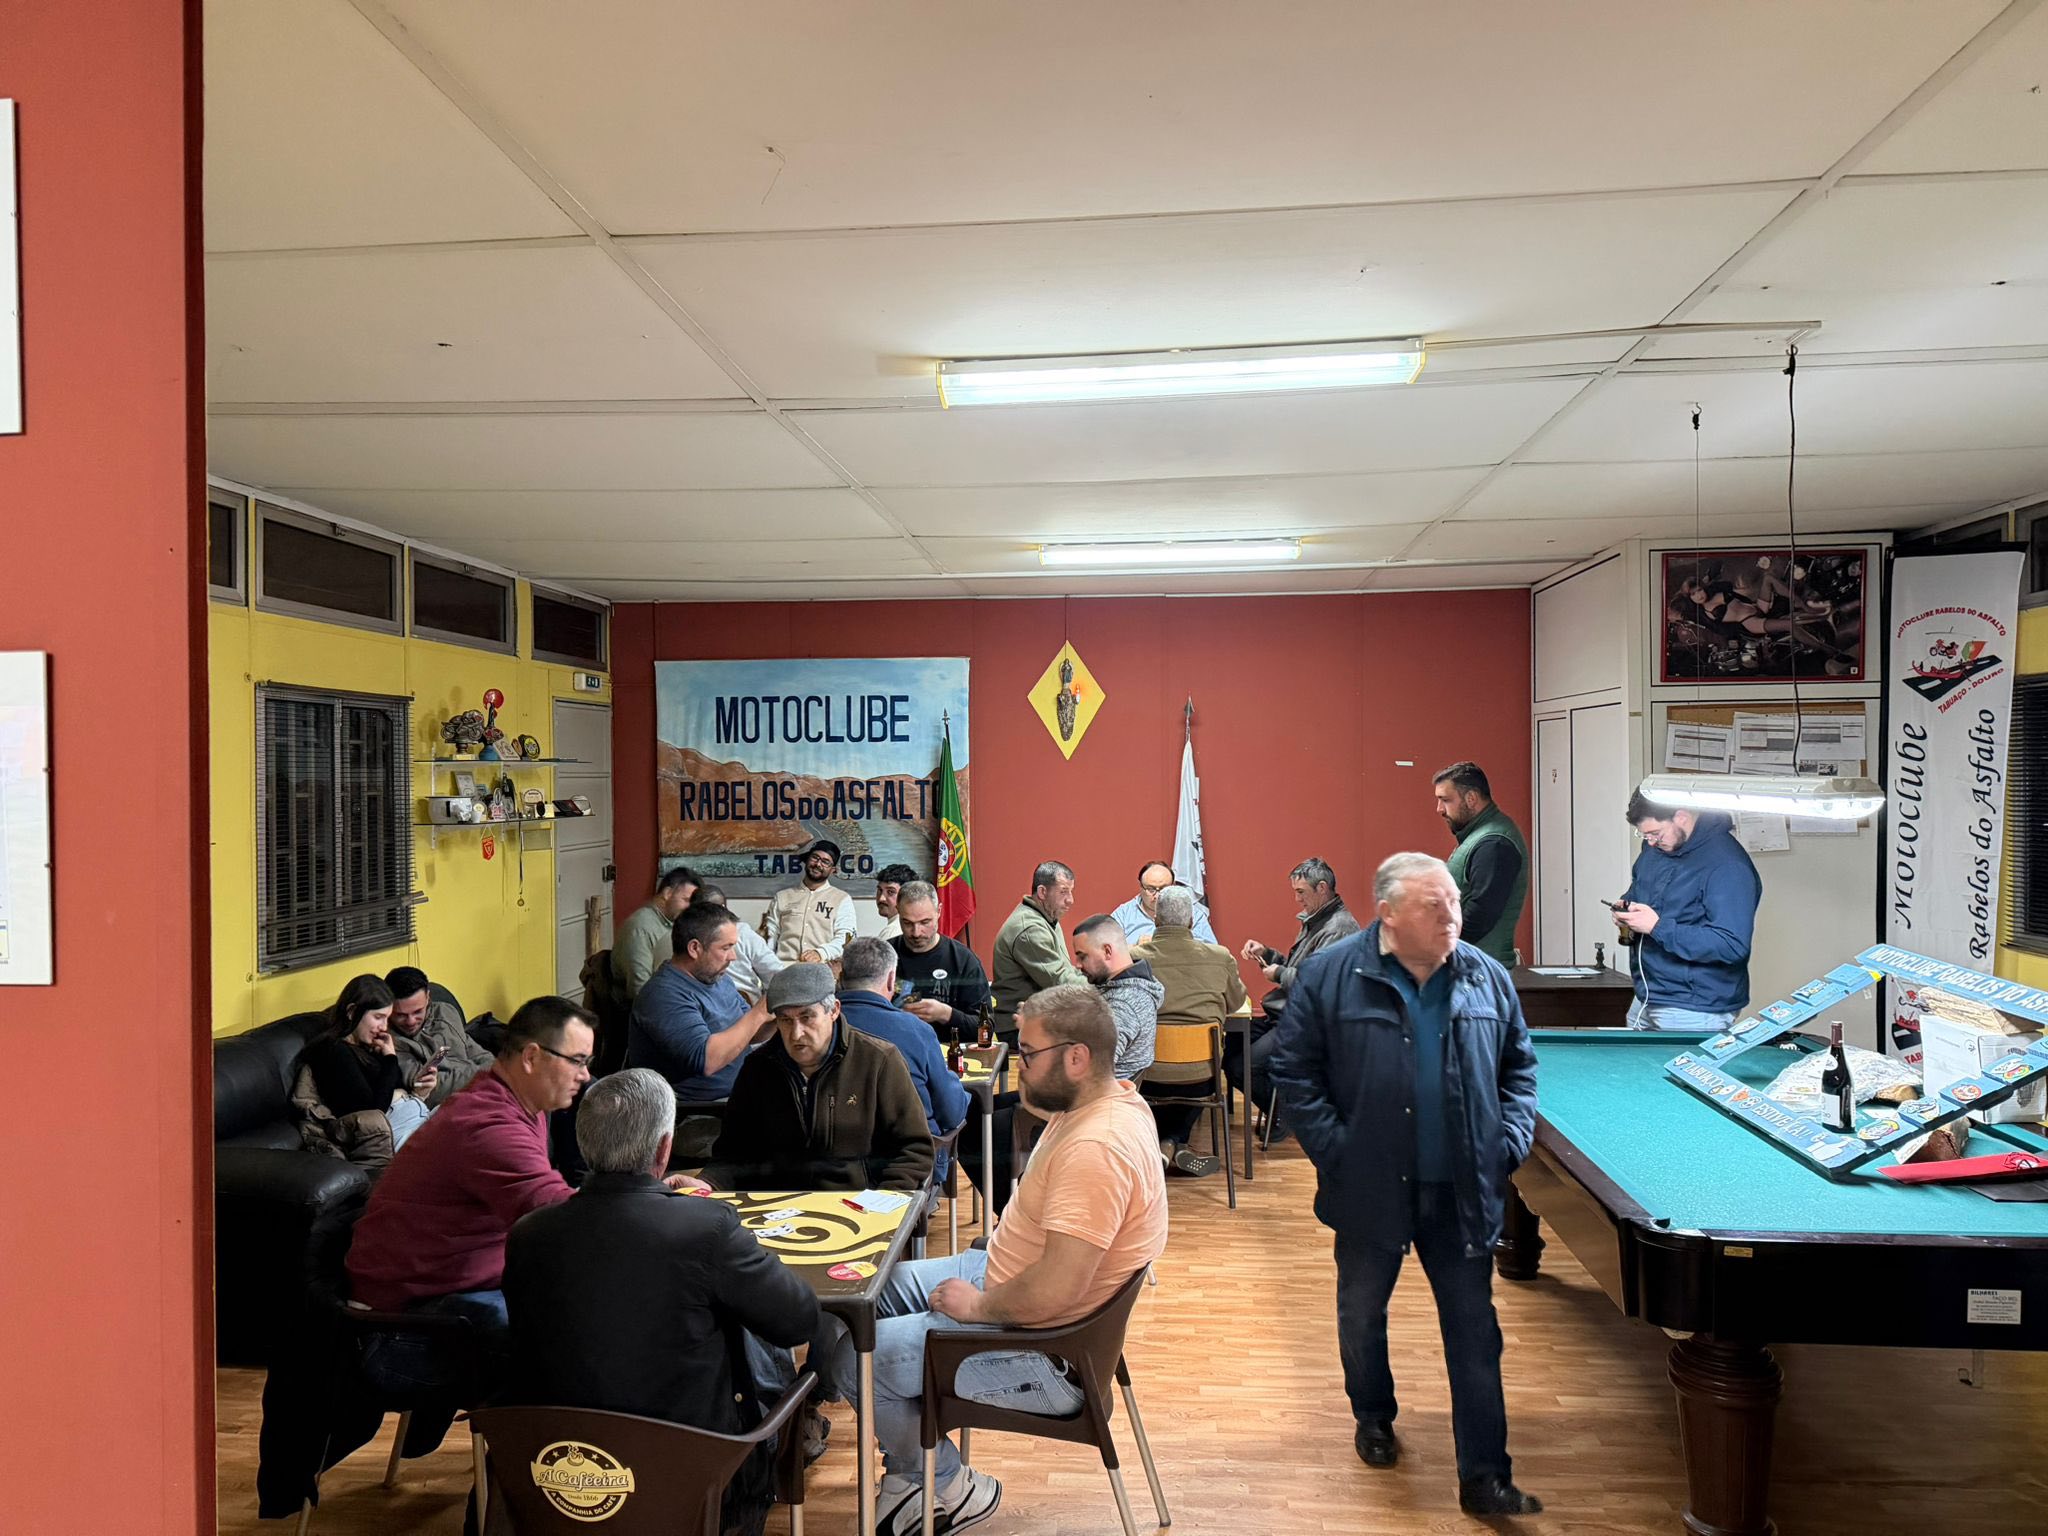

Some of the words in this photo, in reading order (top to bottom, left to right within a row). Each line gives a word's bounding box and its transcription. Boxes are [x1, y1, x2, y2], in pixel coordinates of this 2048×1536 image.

[1935, 607, 1966, 615] RABELOS
[1977, 612, 2006, 637] ASFALTO
[715, 695, 910, 744] MOTOCLUBE
[1937, 688, 1967, 714] TABUAÇO
[1968, 709, 2001, 814] Asfalto
[680, 781, 795, 821] RABELOS
[1894, 722, 1928, 929] Motoclube
[1968, 817, 1993, 850] do
[754, 854, 874, 879] TABÇO
[1968, 856, 1991, 960] Rabelos
[1868, 947, 1945, 976] MOTOCLUBE
[1935, 966, 2002, 995] RABELOS
[556, 1497, 593, 1516] COMPANHIA
